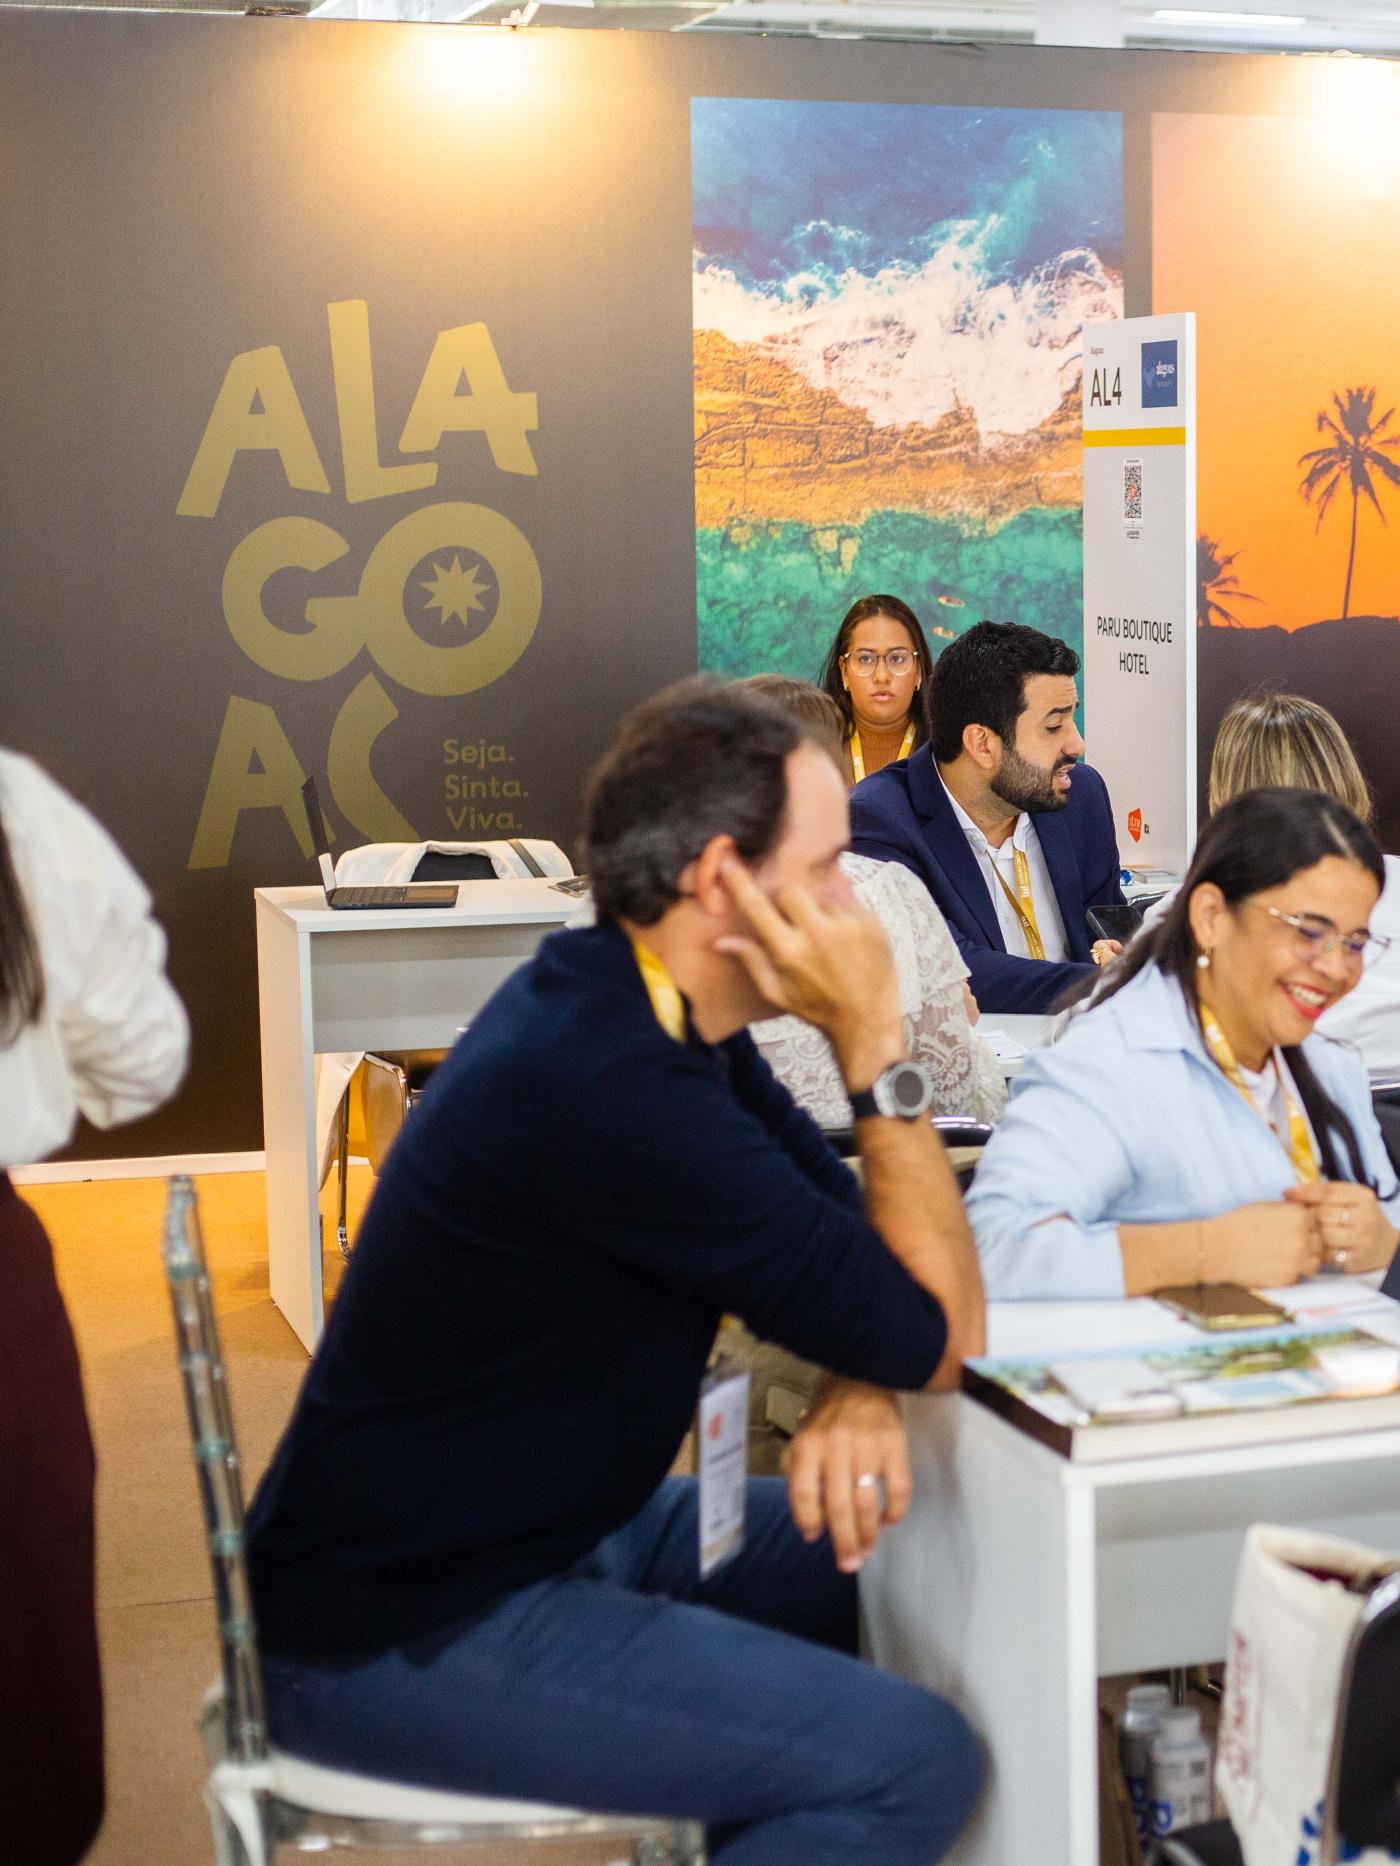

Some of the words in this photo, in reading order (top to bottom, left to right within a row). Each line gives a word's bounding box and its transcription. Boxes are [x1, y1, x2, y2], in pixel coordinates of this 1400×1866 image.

[1090, 366, 1122, 407] AL4
[1096, 615, 1121, 638] PARU
[1123, 618, 1173, 645] BOUTIQUE
[1119, 651, 1150, 675] HOTEL
[443, 737, 515, 769] Seja.
[444, 773, 530, 801] Sinta.
[446, 804, 523, 831] Viva.
